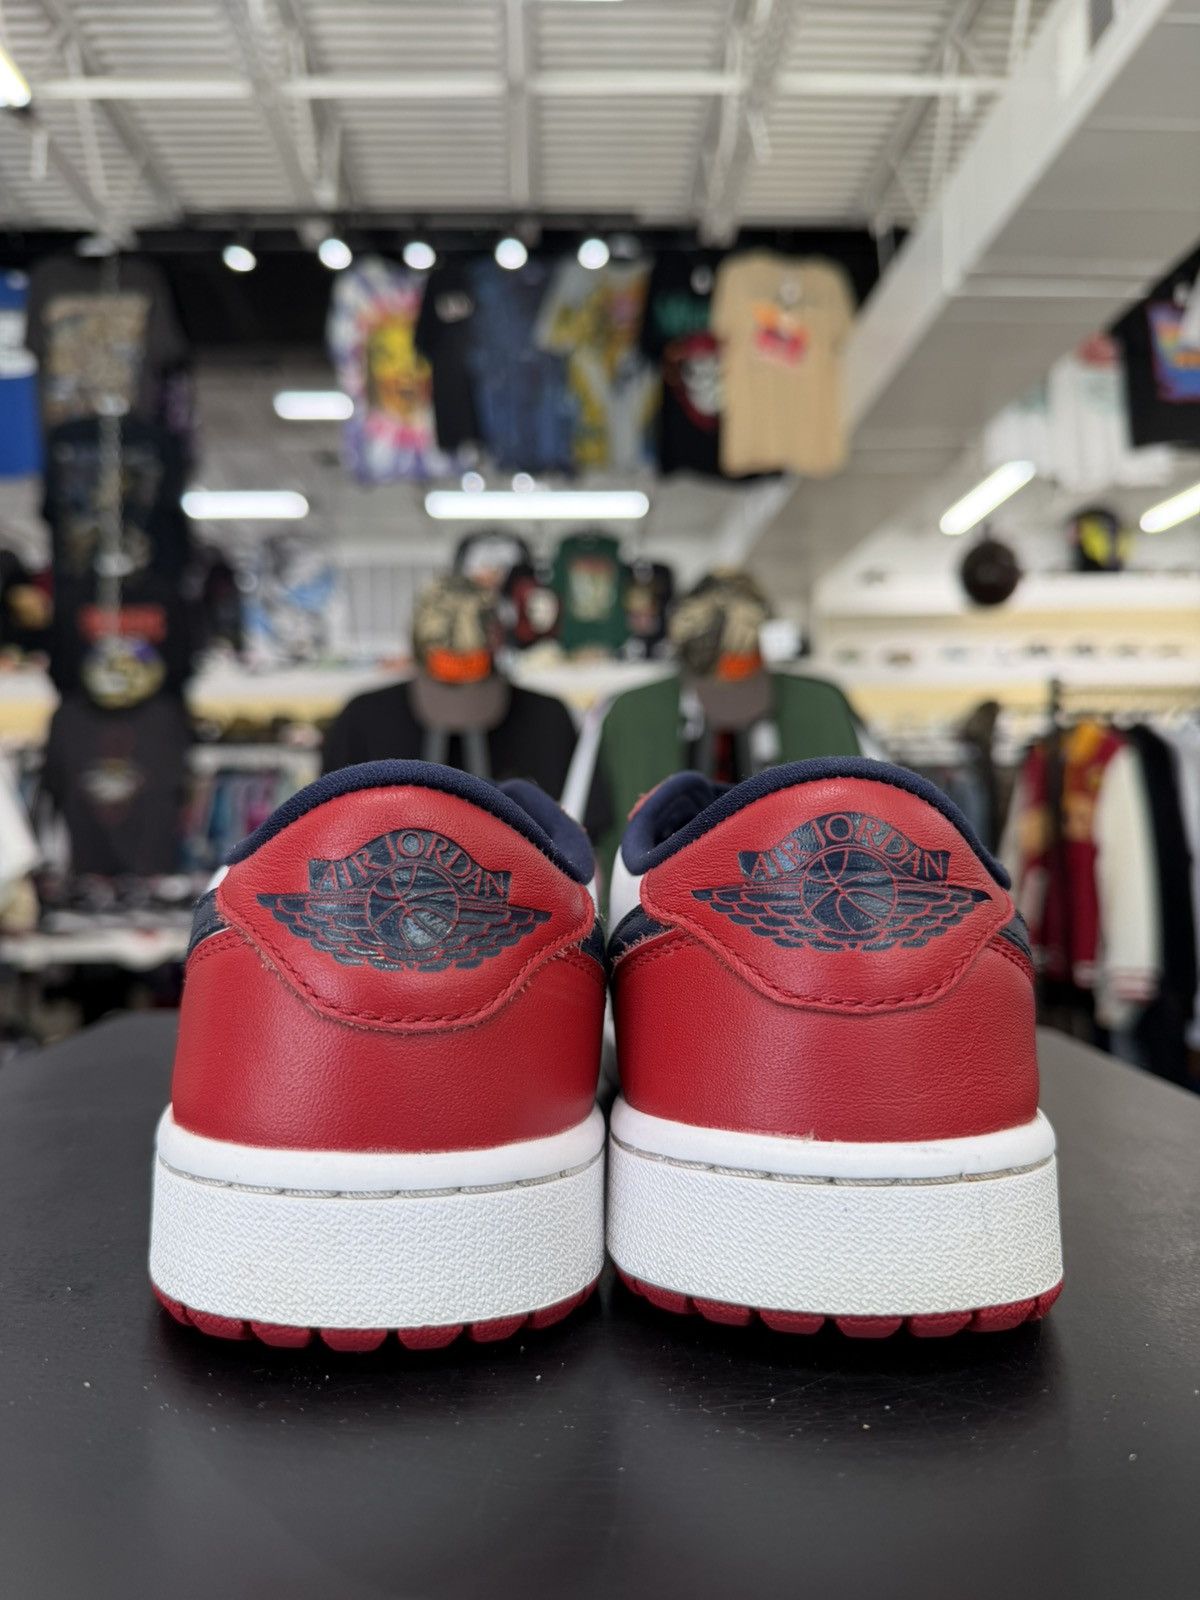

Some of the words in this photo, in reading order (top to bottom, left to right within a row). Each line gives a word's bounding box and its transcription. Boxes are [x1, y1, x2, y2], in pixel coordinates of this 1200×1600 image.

[318, 850, 382, 890] AIR
[383, 831, 506, 897] JORDAN
[751, 838, 813, 880] AIR
[812, 814, 944, 878] JORDAN
